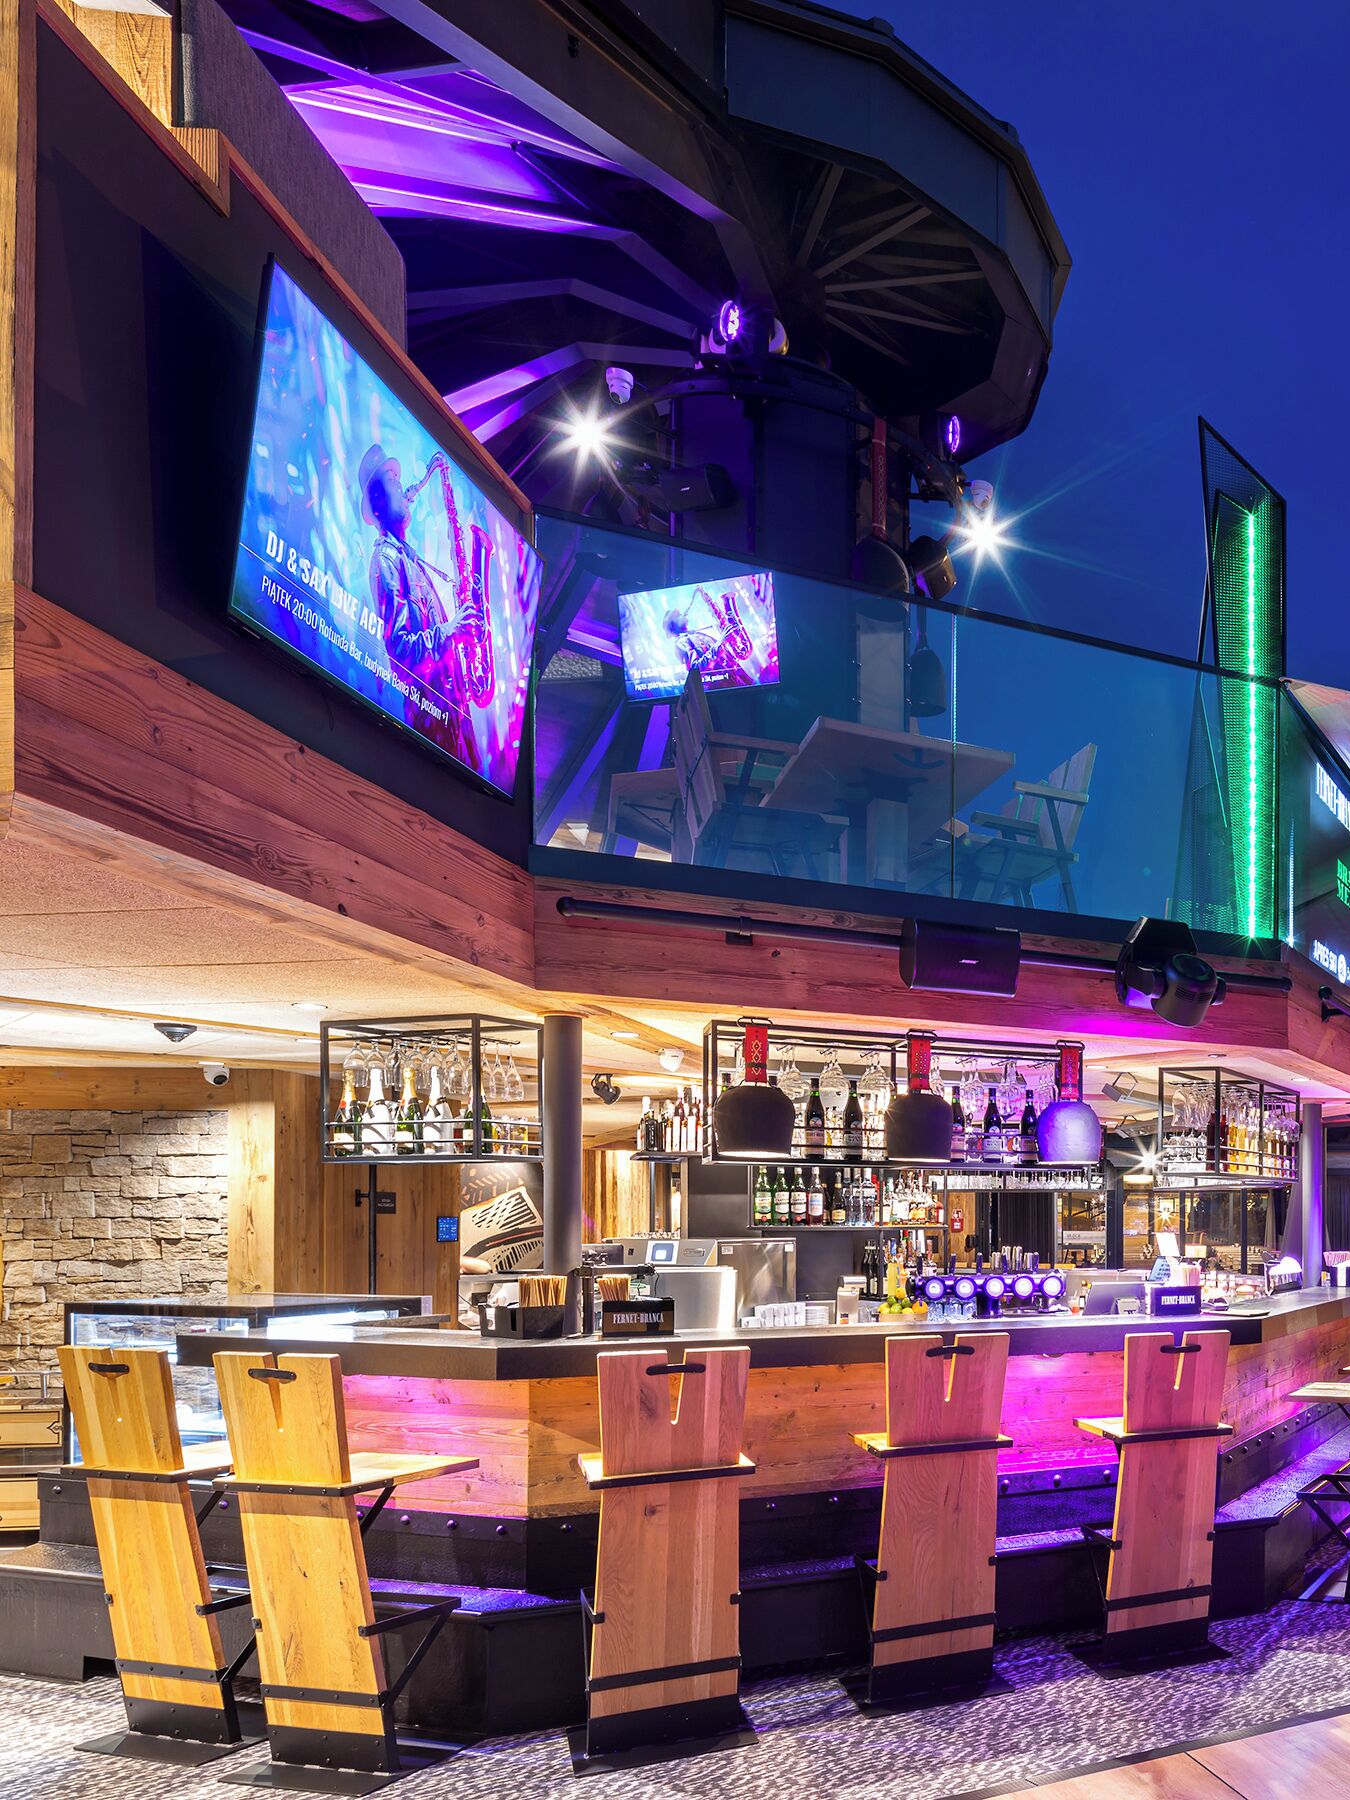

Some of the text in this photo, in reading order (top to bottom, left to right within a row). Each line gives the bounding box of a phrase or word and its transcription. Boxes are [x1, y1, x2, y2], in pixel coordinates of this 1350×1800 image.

[266, 530, 285, 563] DJ
[287, 547, 298, 575] &
[300, 557, 329, 599] SAX
[360, 605, 385, 640] ACT
[261, 575, 292, 611] PIĄTEK
[292, 598, 318, 629] 20:00
[318, 618, 349, 653] Rotunda
[364, 652, 392, 684] budynek
[391, 672, 410, 697] Bania
[421, 698, 442, 721] poziom
[441, 711, 449, 725] +1
[612, 1312, 665, 1324] FERNET-BRANCA
